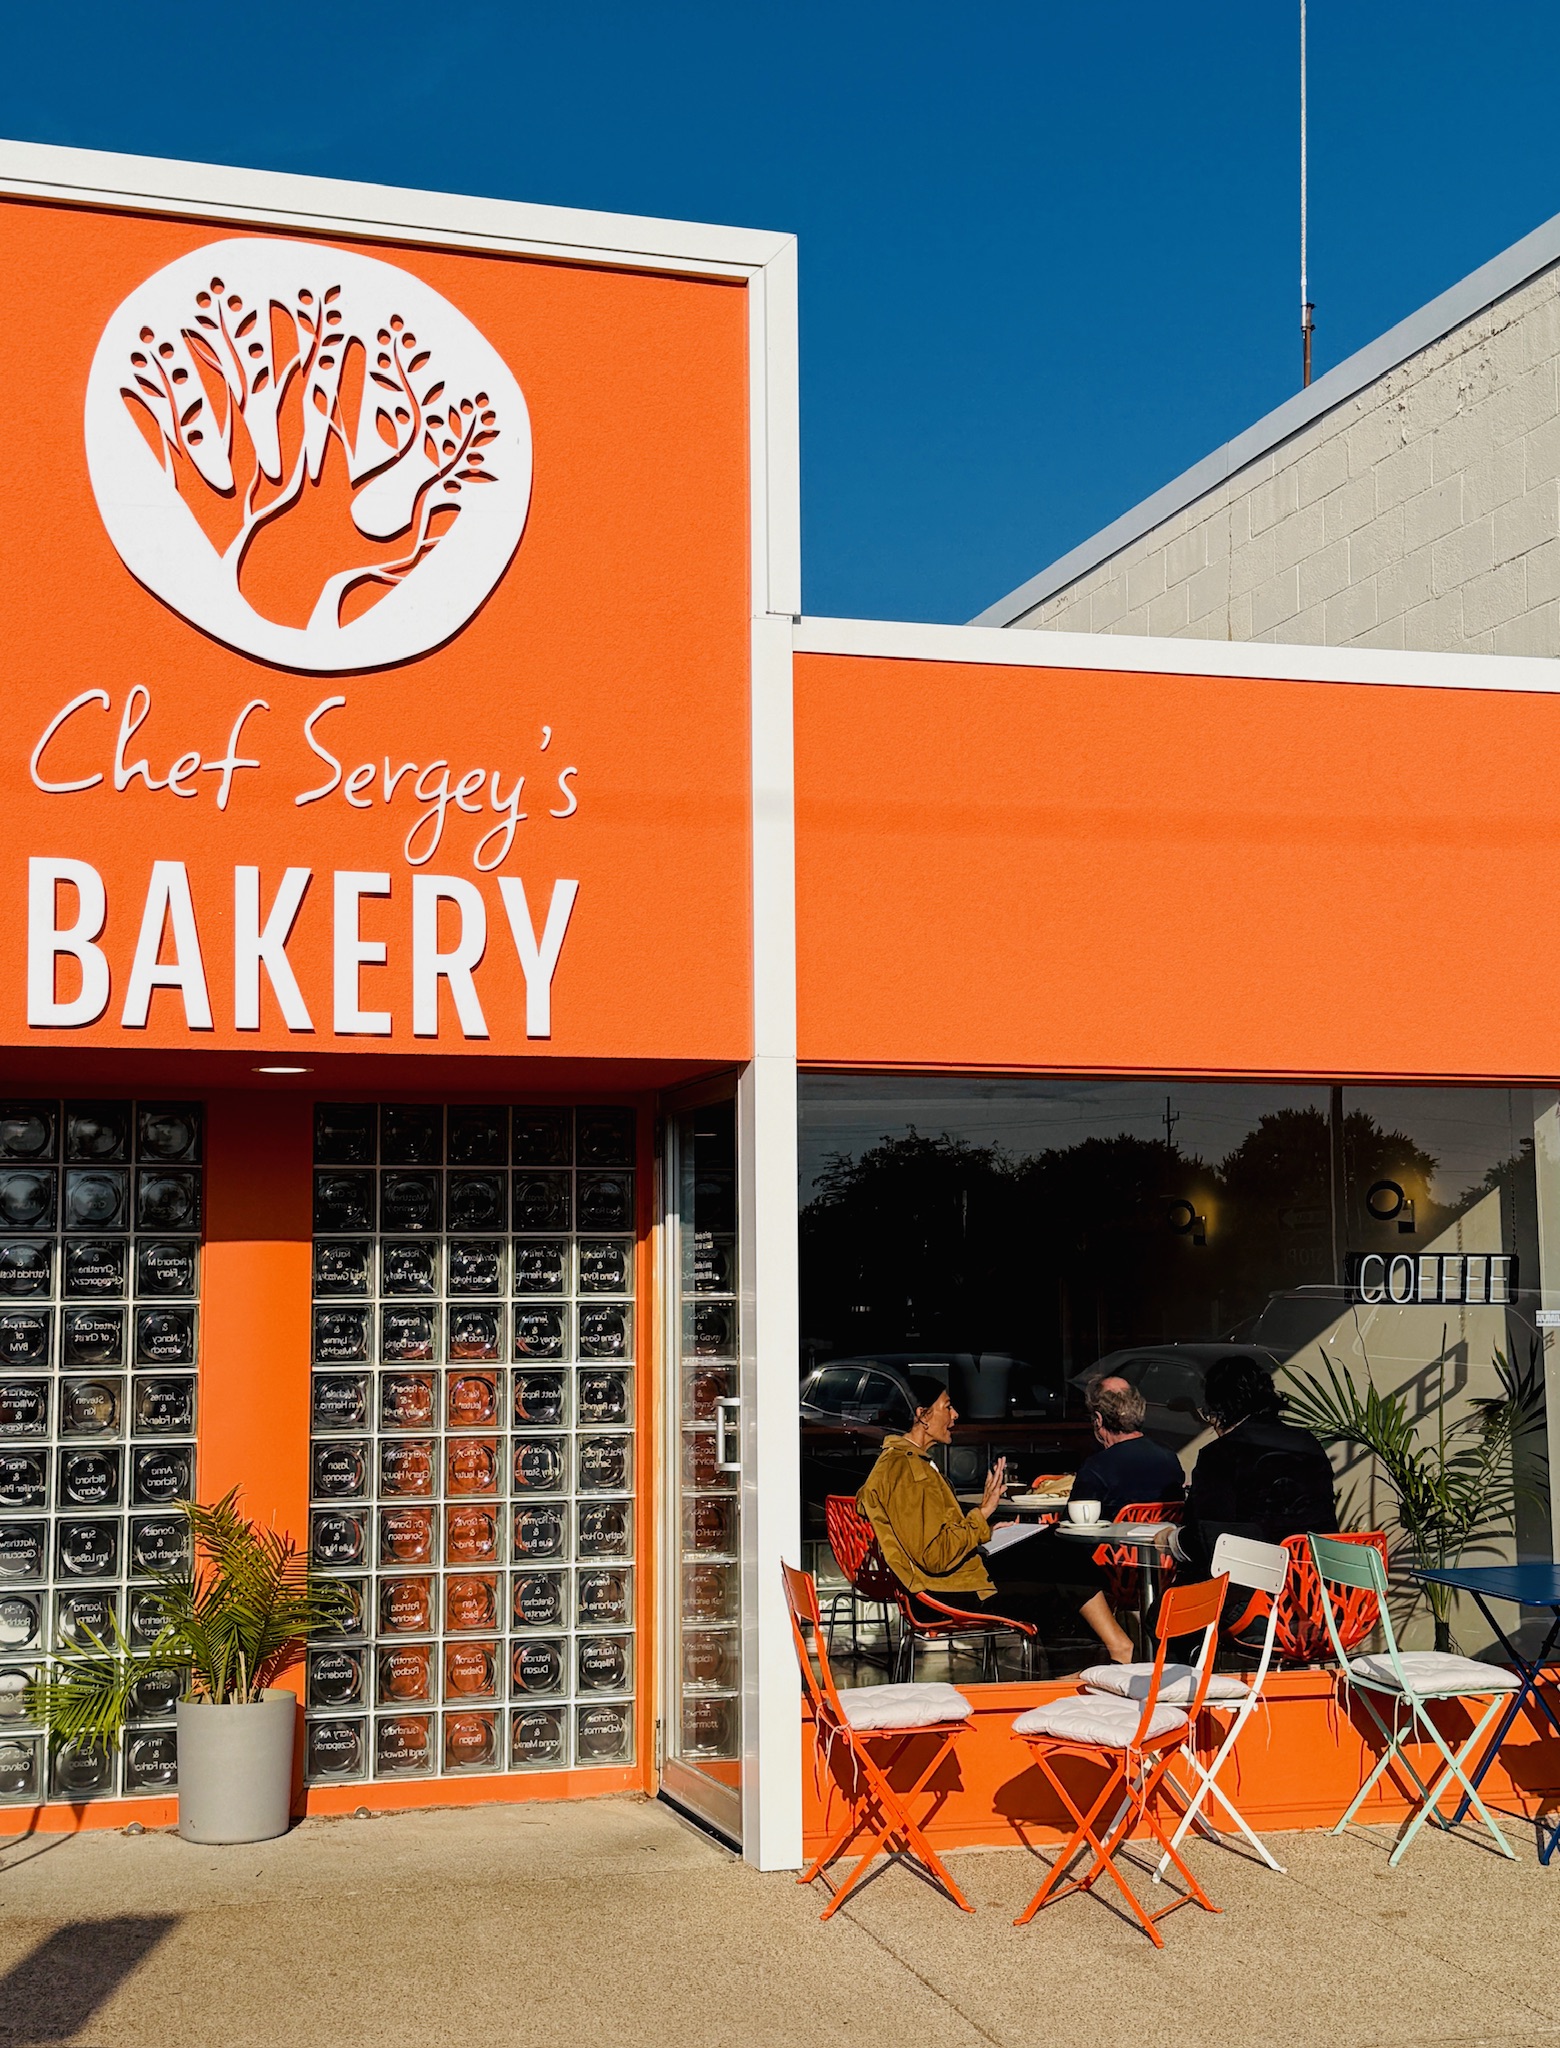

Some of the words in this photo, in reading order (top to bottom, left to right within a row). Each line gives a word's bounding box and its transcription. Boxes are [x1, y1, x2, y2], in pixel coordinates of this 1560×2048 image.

[30, 684, 270, 810] Chef
[295, 696, 578, 872] Sergey's
[27, 856, 579, 1040] BAKERY
[1359, 1254, 1512, 1304] COFFEE
